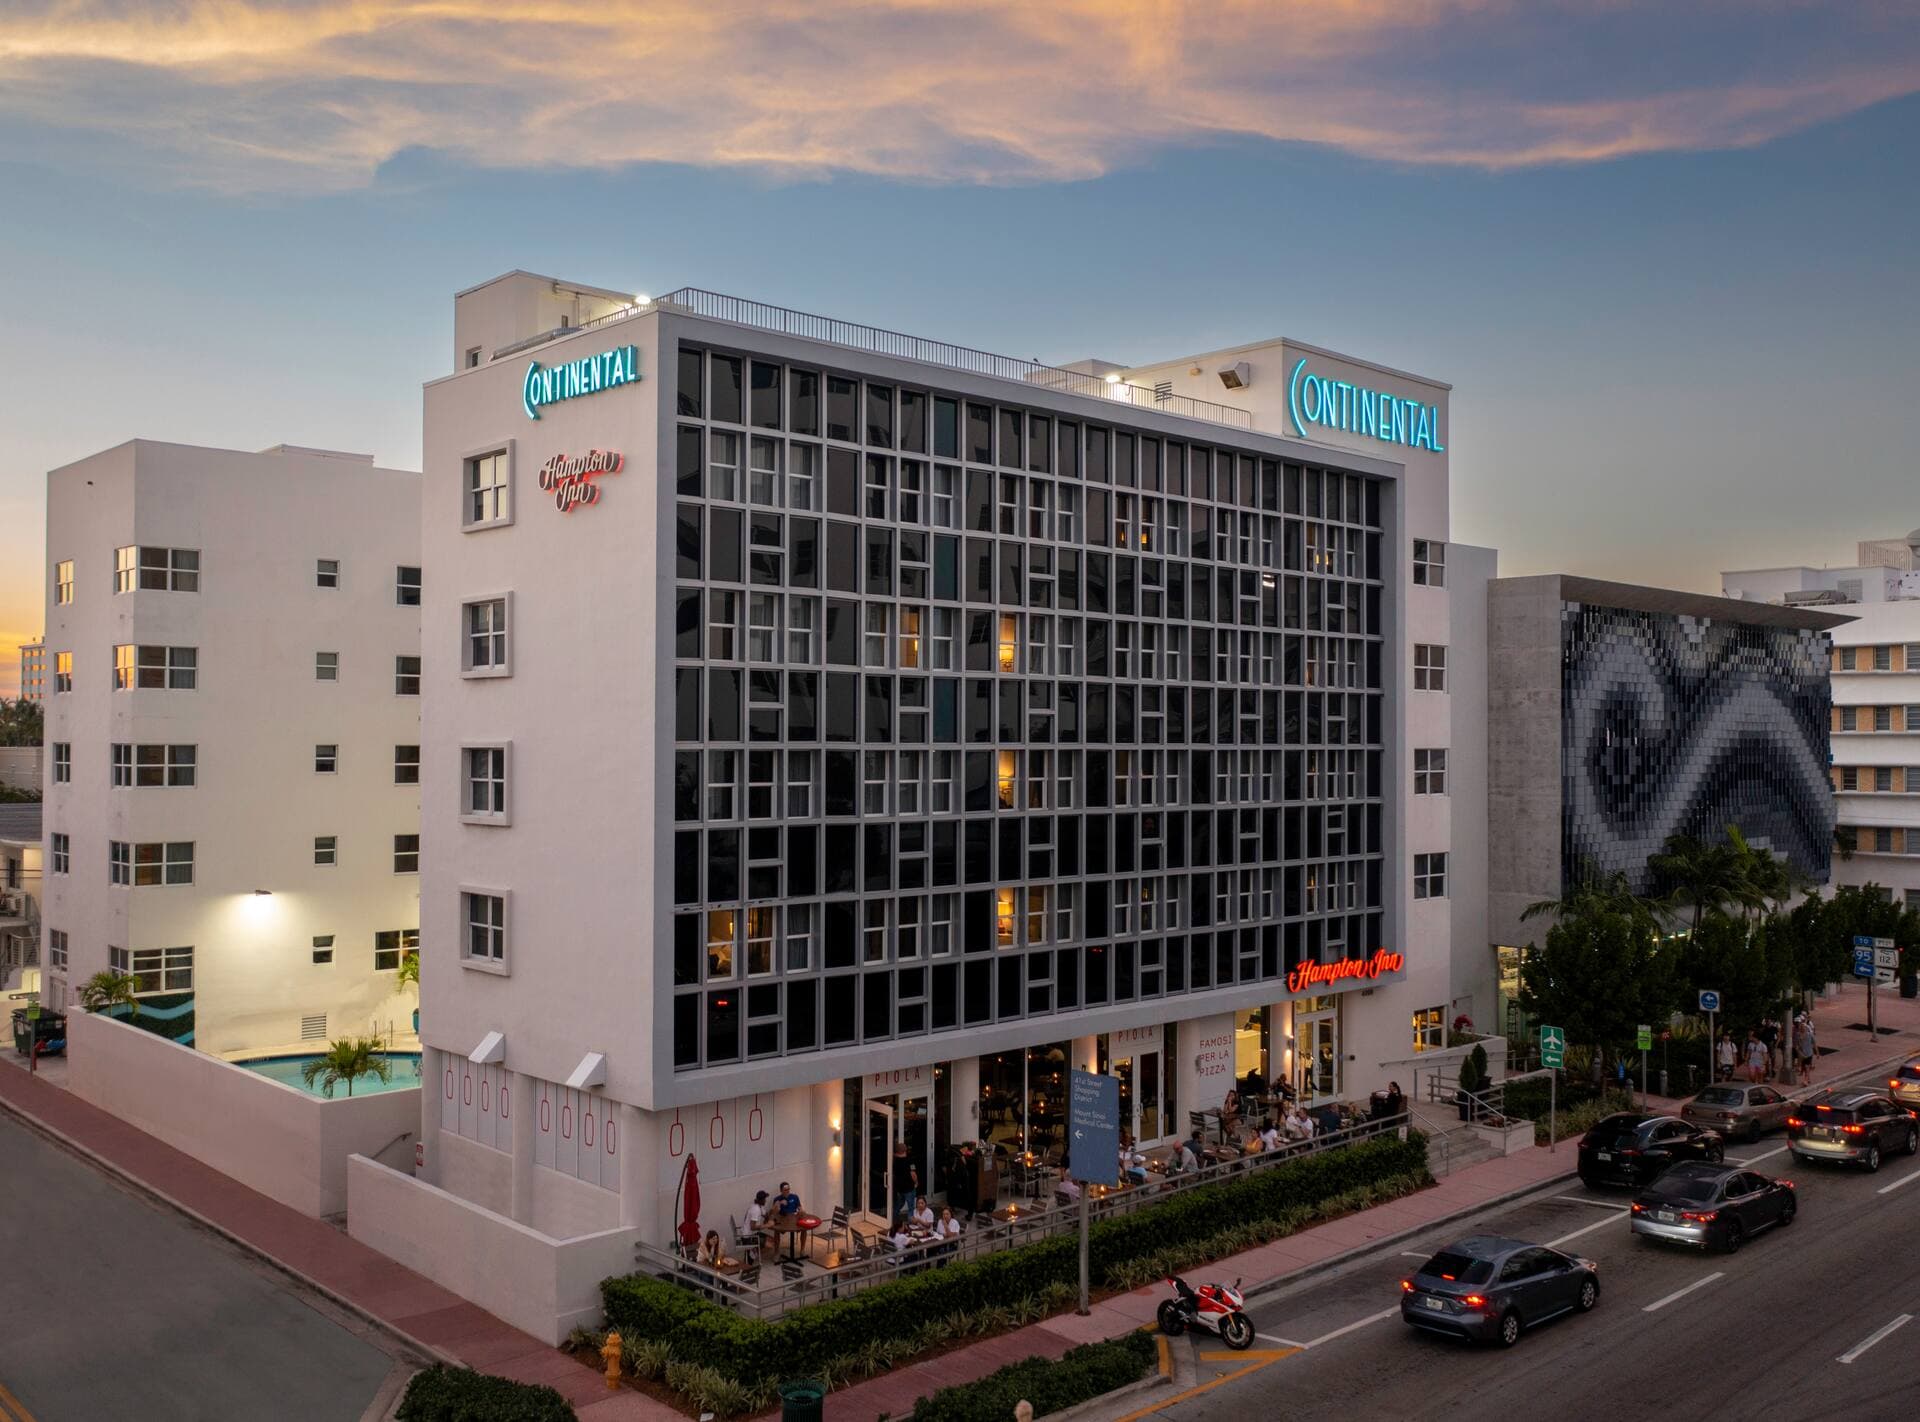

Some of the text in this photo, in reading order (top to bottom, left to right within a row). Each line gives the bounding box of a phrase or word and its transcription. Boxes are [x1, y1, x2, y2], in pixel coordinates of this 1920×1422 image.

[523, 345, 641, 420] CONTINENTAL
[1289, 359, 1444, 452] CONTINENTAL
[539, 450, 621, 490] Hampton
[555, 481, 598, 512] Inn
[1855, 950, 1871, 961] 95
[1879, 956, 1891, 964] 112
[1287, 948, 1404, 993] Hampton Inn
[1118, 1026, 1153, 1043] PIOLA
[1199, 1034, 1232, 1049] FAMOSI
[1199, 1049, 1229, 1063] PER LA
[875, 1067, 920, 1086] PIOLA
[1199, 1063, 1226, 1077] PIZZA
